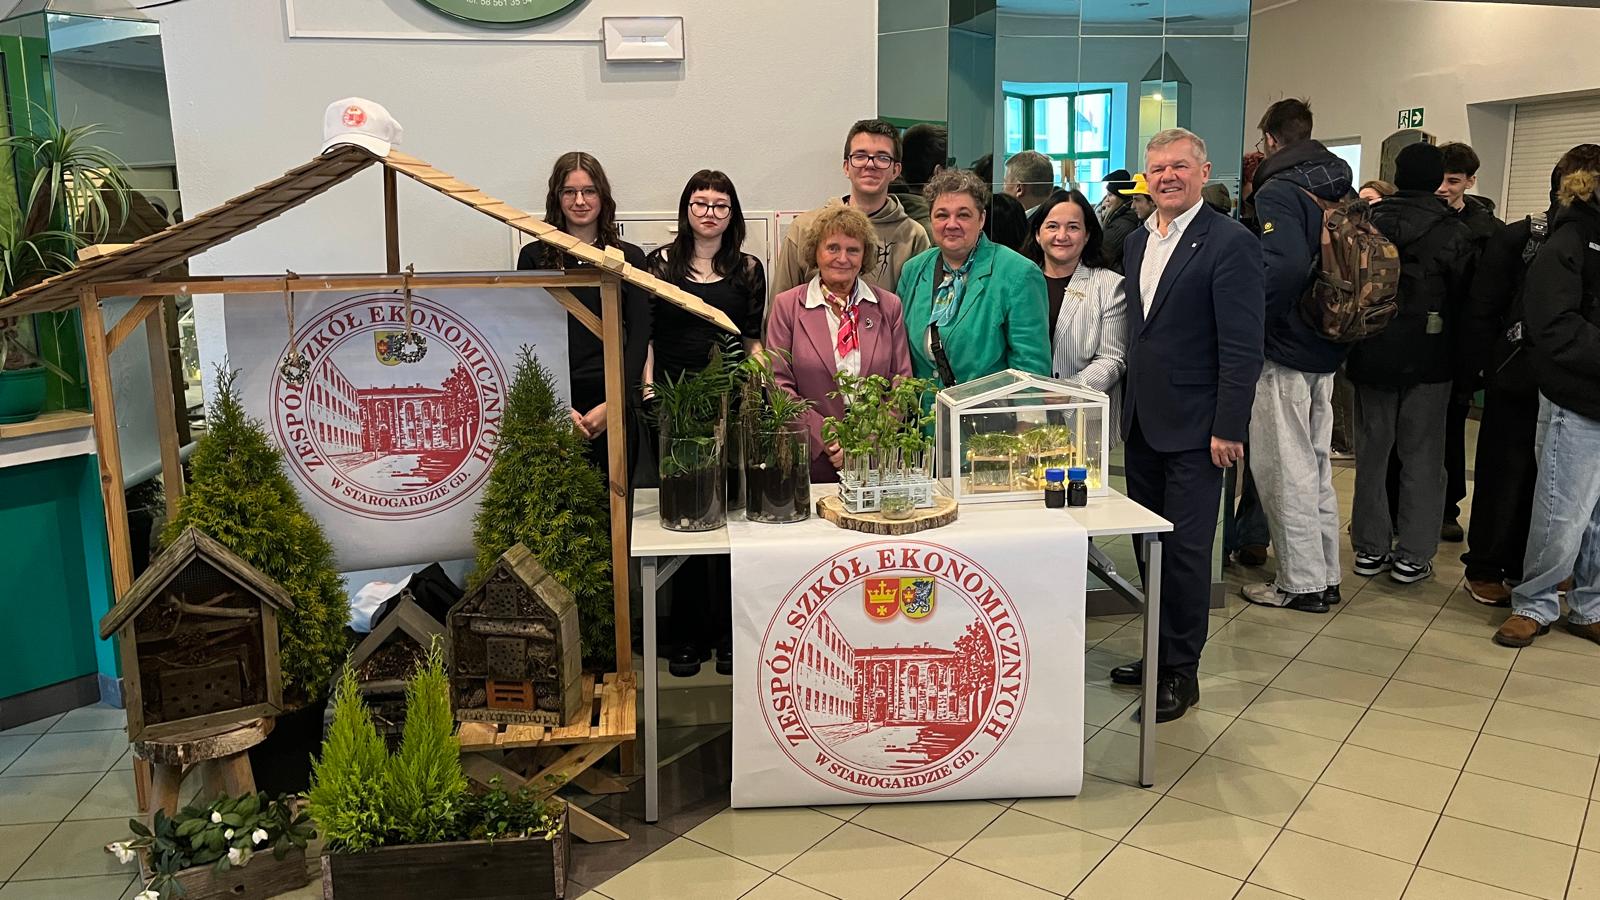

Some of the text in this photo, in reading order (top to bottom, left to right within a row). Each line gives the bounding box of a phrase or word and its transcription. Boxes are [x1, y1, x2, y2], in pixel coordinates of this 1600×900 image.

[297, 312, 363, 365] ZKÓŁ
[368, 304, 501, 464] EKONOMICZNYCH
[330, 472, 471, 508] W STAROGARDZIE GD.
[765, 547, 1021, 748] ZESPÓŁ SZKÓŁ EKONOMICZNYCH
[815, 751, 979, 789] W STAROGARDZIE GD.
